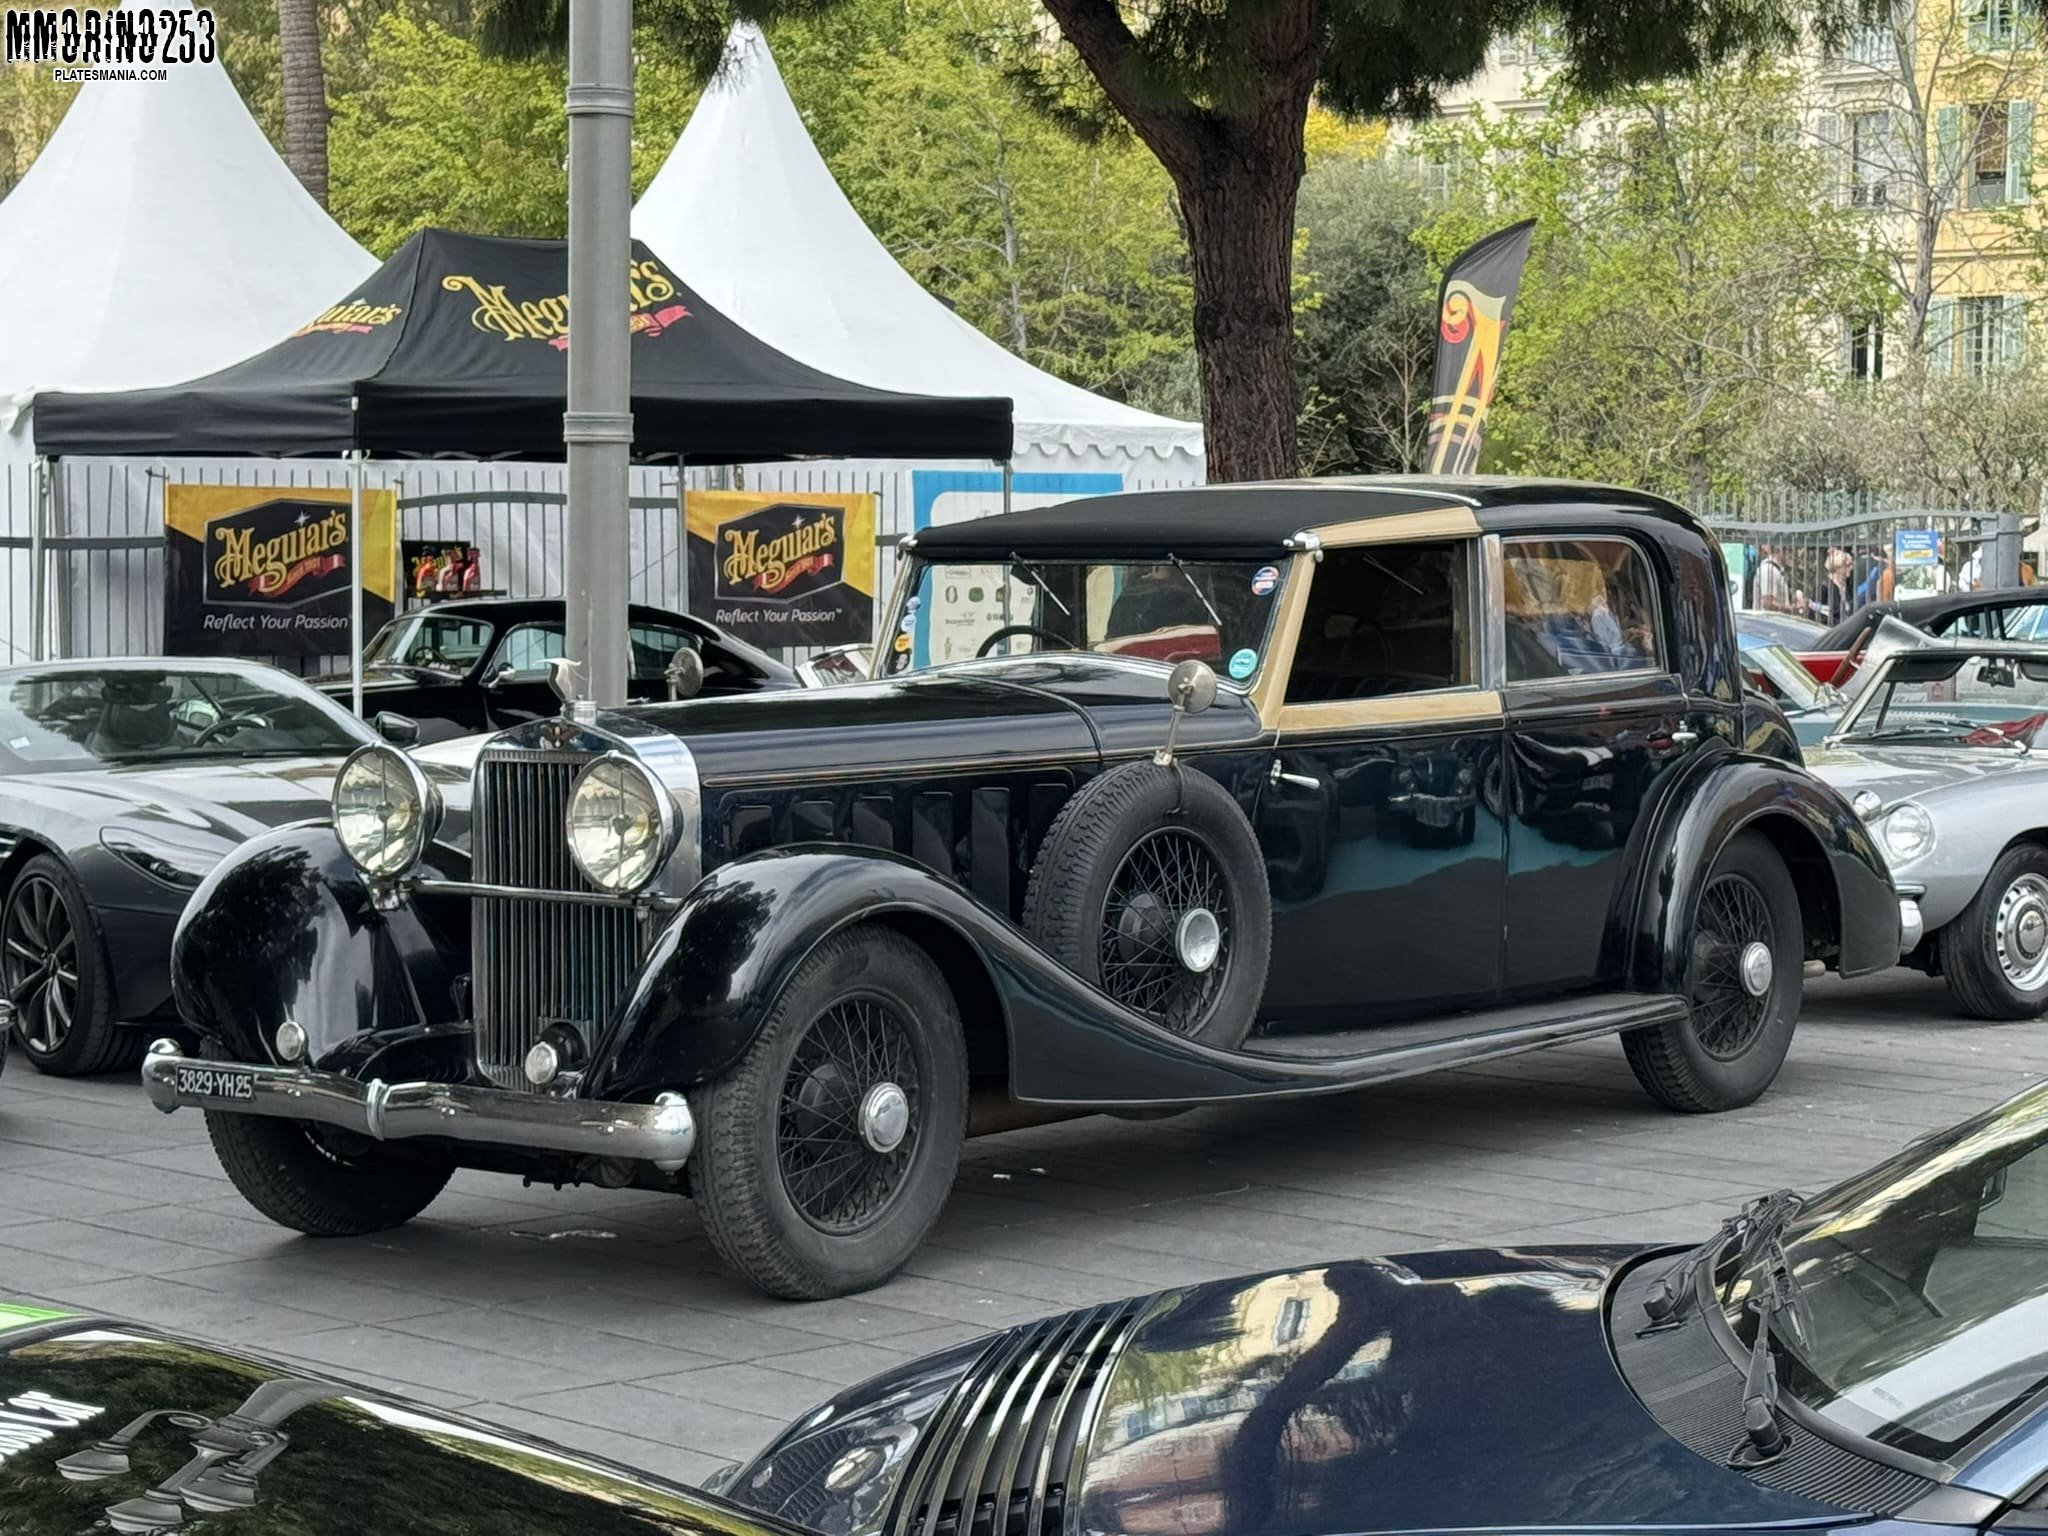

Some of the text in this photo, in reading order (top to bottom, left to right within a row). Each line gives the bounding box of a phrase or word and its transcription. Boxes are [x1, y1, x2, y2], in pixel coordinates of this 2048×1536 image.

[214, 509, 347, 593] Meguiar's
[723, 512, 836, 589] Meguiar's
[203, 613, 254, 634] Reflect
[260, 614, 293, 630] Your
[716, 607, 759, 627] Reflect
[763, 609, 789, 622] Your
